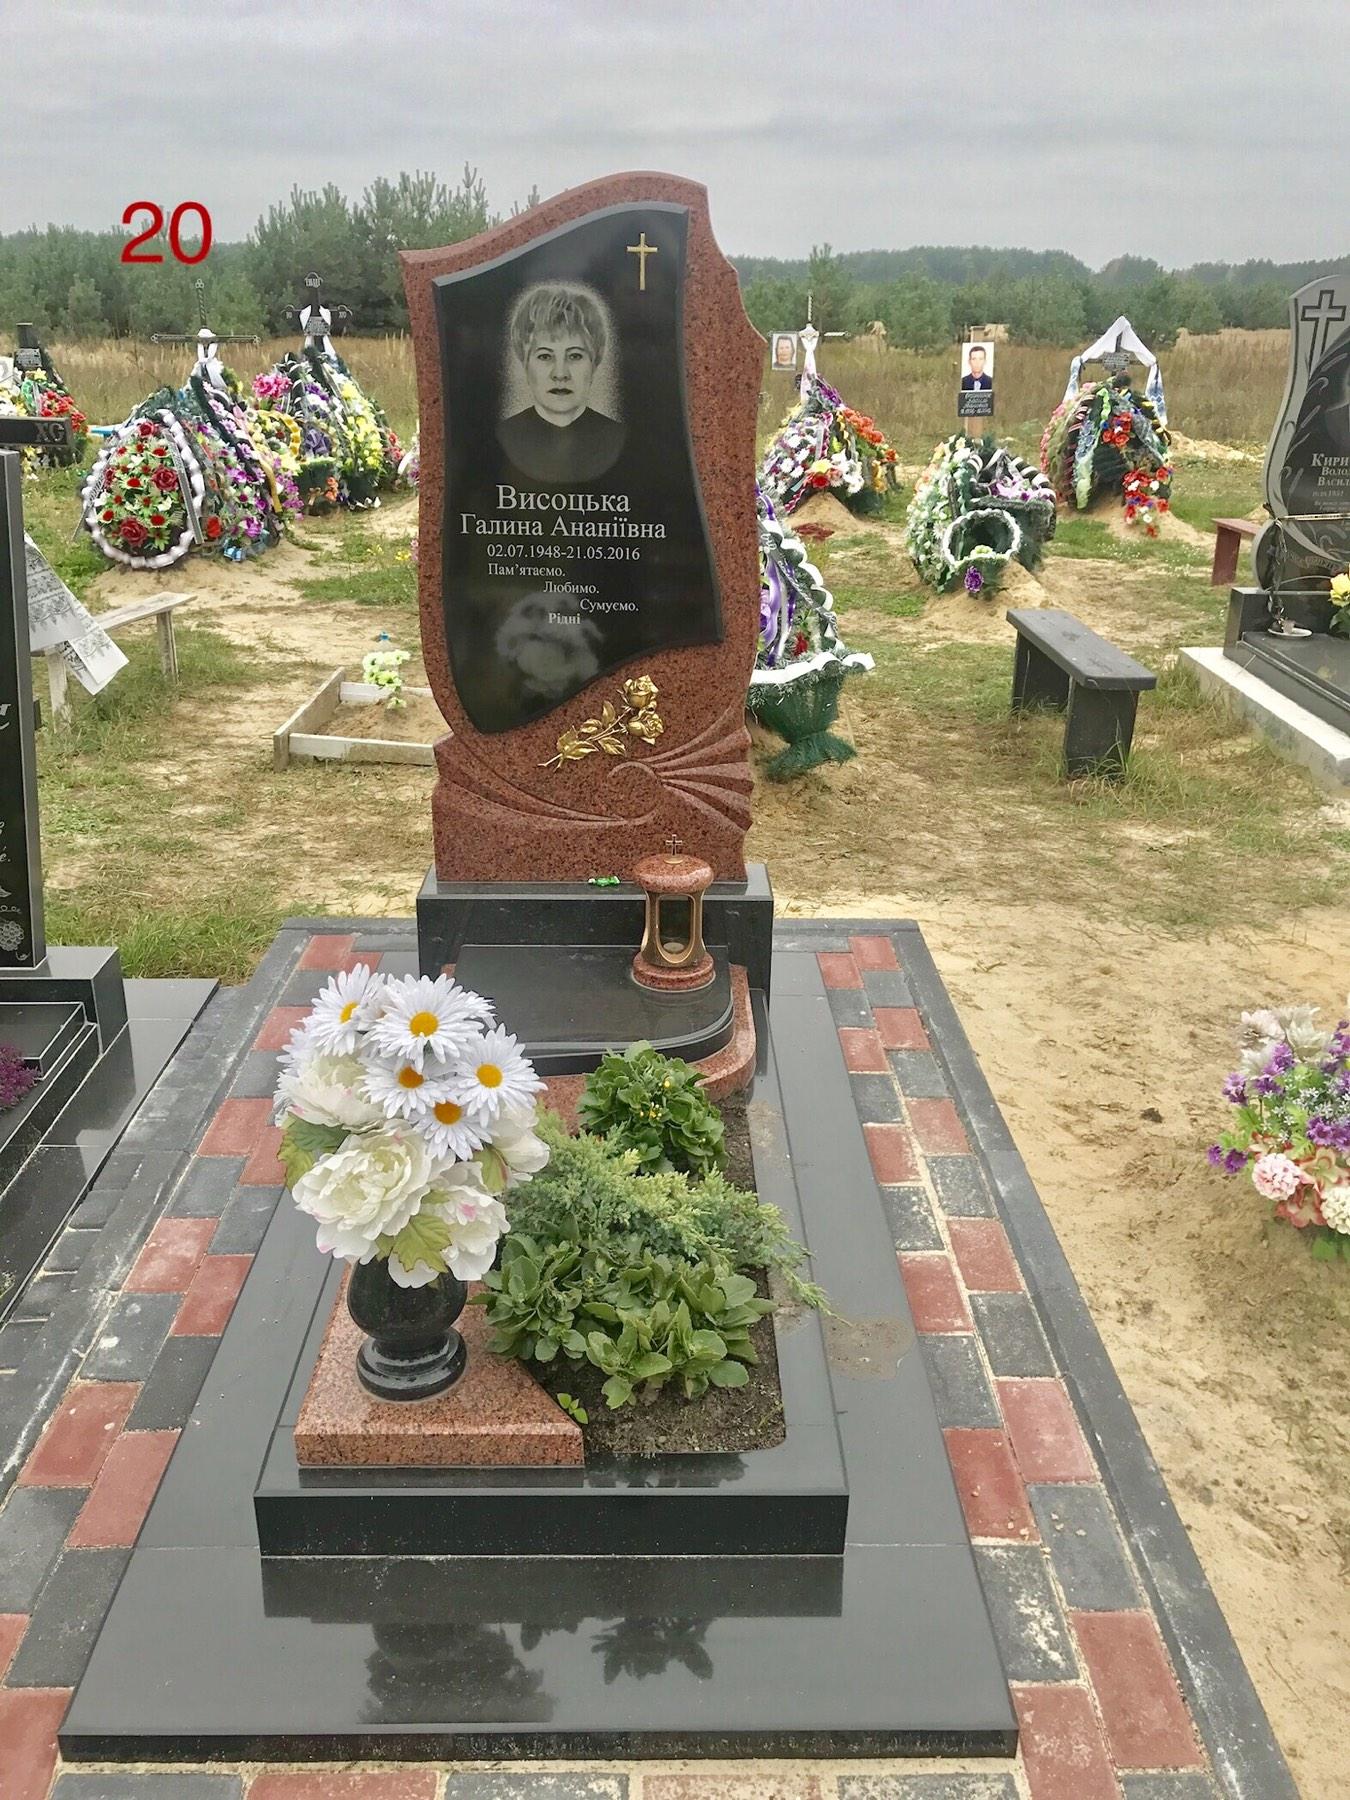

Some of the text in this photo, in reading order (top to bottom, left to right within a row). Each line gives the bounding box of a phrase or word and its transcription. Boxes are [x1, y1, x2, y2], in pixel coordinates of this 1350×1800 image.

[496, 484, 631, 515] Висоцька
[460, 513, 667, 539] Галина Ананіївна
[487, 544, 640, 561] 02.07.1948-21.05.2016
[543, 581, 600, 594] Любимо.
[580, 599, 639, 613] Сумуємо.
[548, 613, 581, 624] Рідні
